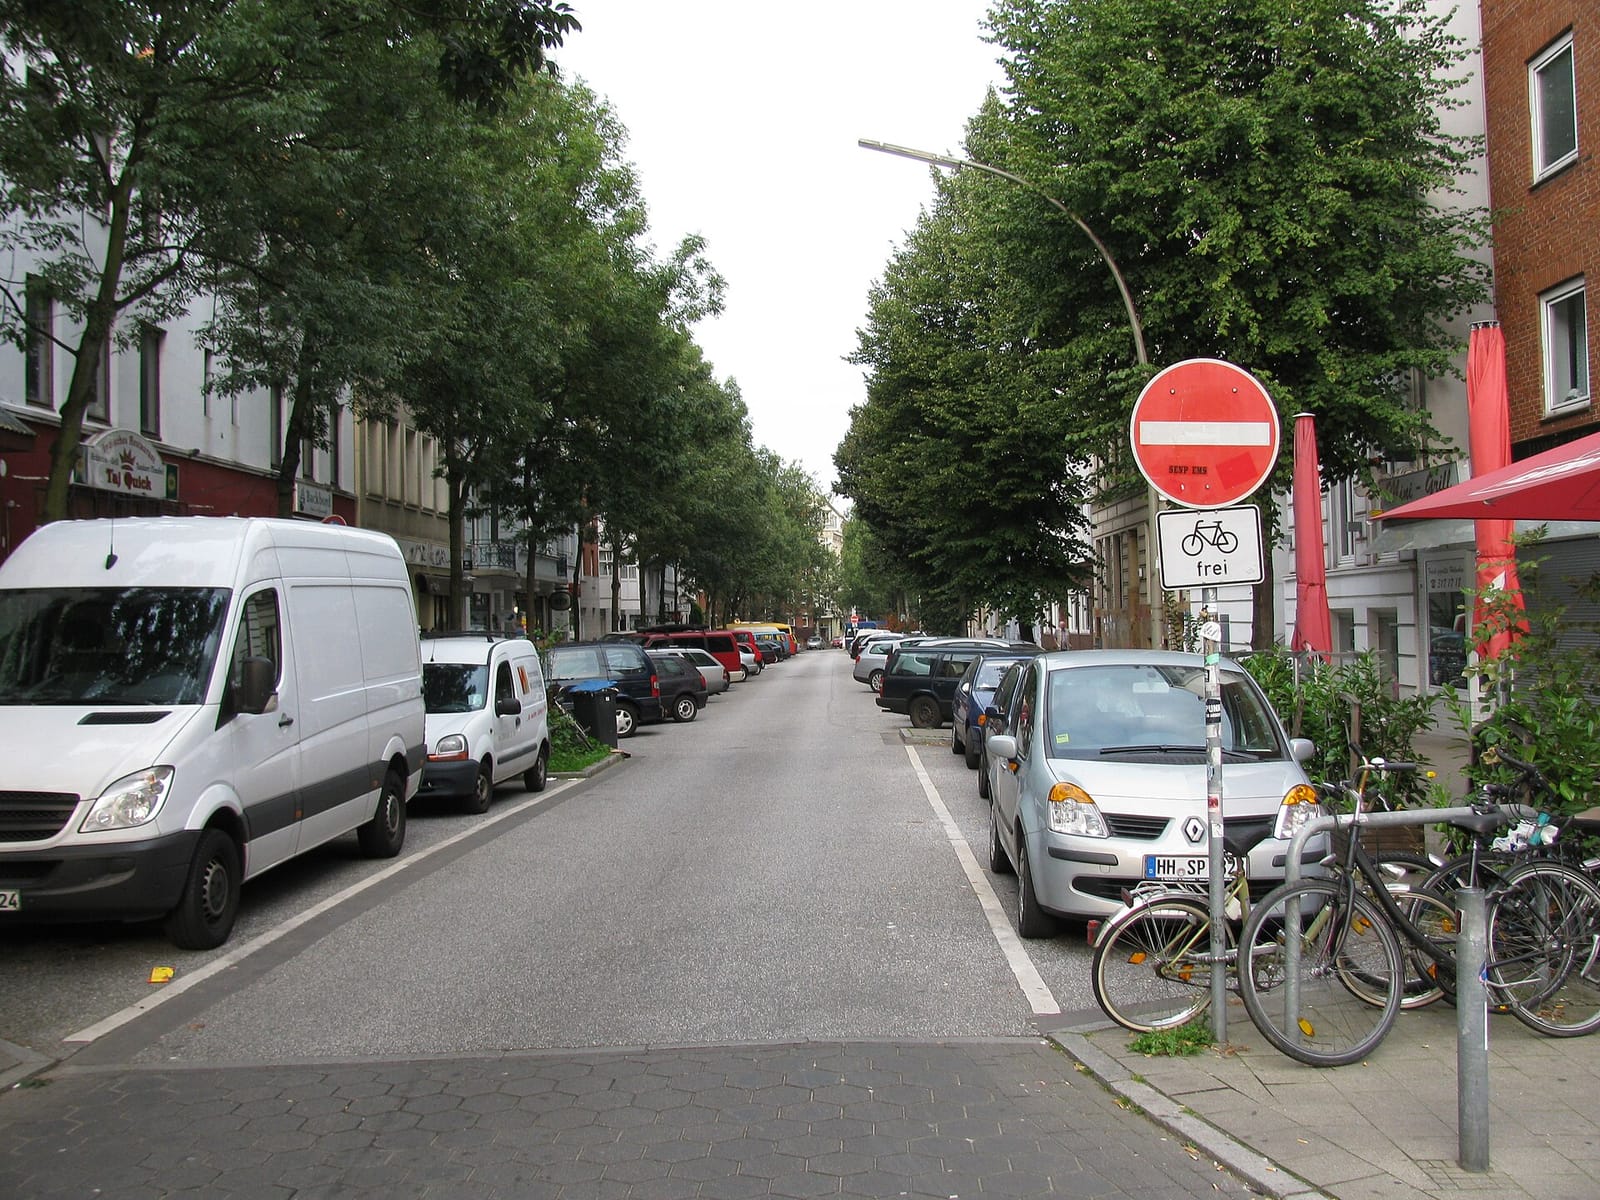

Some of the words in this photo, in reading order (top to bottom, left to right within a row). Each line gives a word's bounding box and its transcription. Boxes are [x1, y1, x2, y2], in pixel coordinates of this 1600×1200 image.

[106, 467, 121, 488] Taj
[124, 471, 152, 491] Quick
[1197, 559, 1228, 577] frei
[1157, 859, 1176, 875] HH
[1187, 859, 1206, 875] SP
[0, 893, 17, 908] 24
